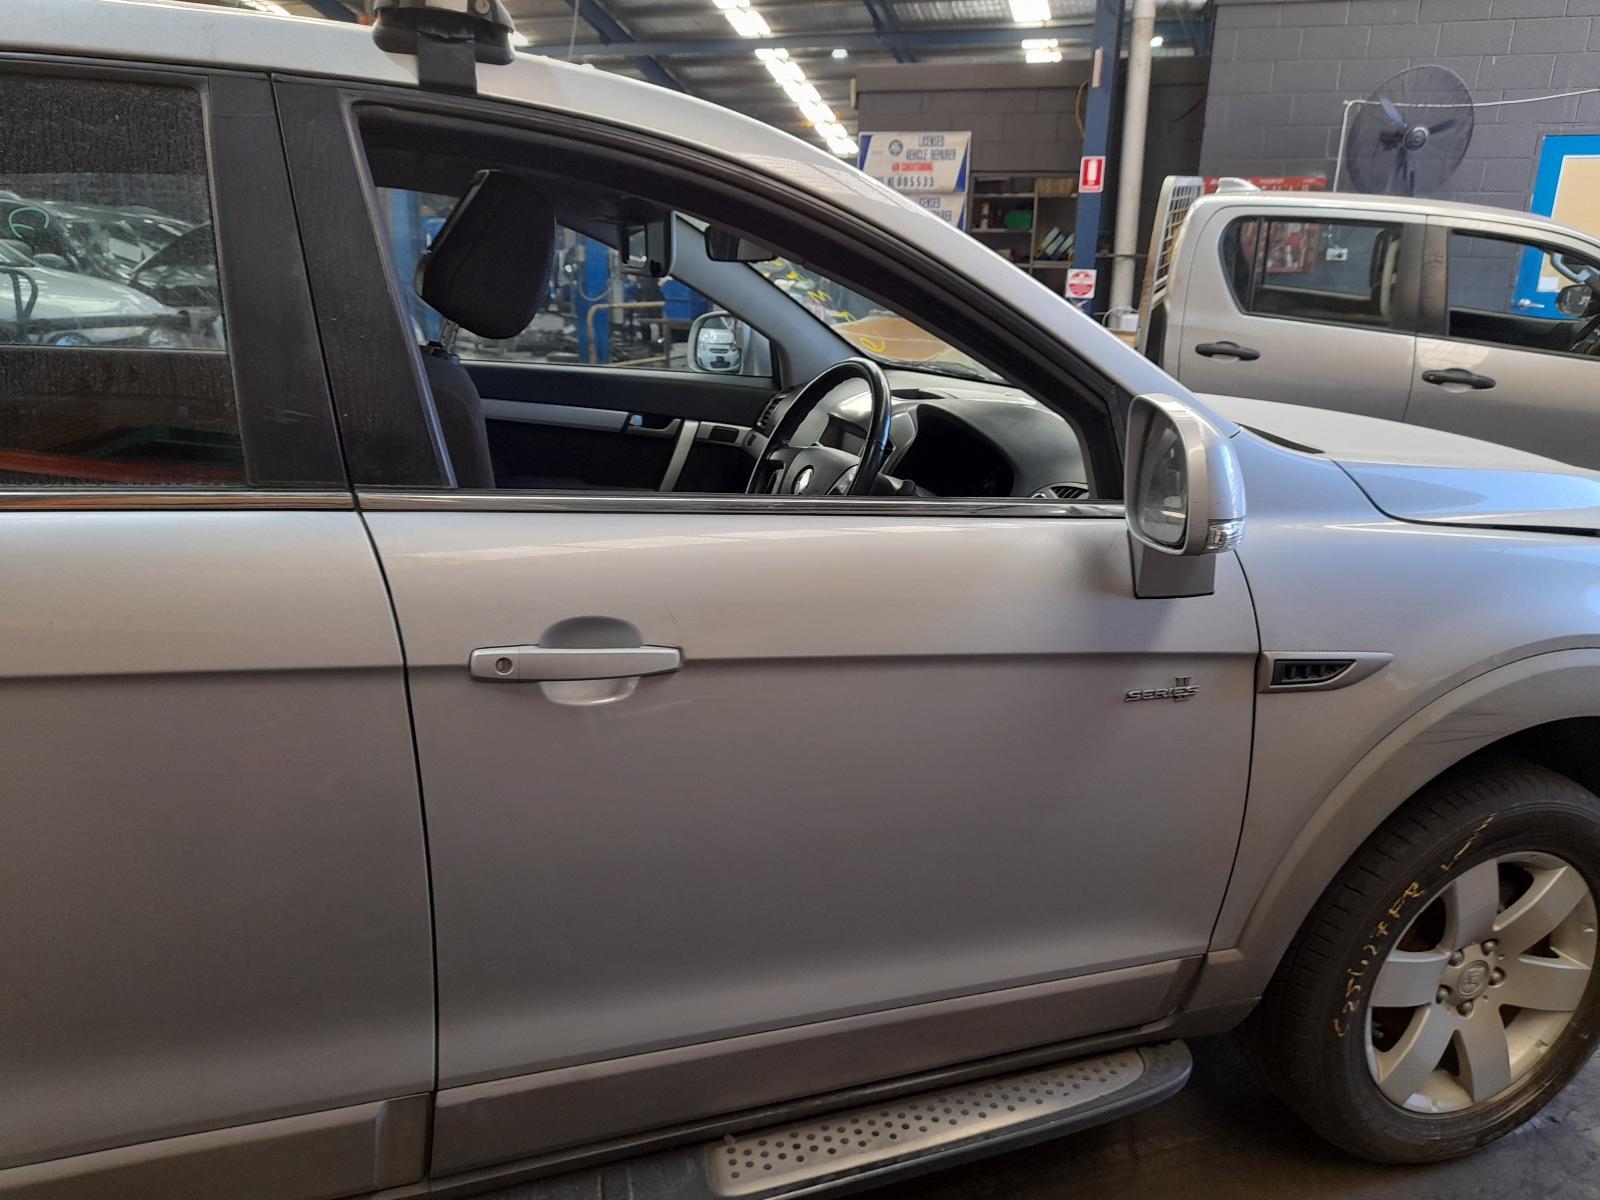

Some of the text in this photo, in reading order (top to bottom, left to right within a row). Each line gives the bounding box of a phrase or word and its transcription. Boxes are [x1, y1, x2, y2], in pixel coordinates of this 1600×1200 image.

[906, 149, 956, 161] VEHICLE REPAIRER
[1124, 685, 1200, 702] SERIES
